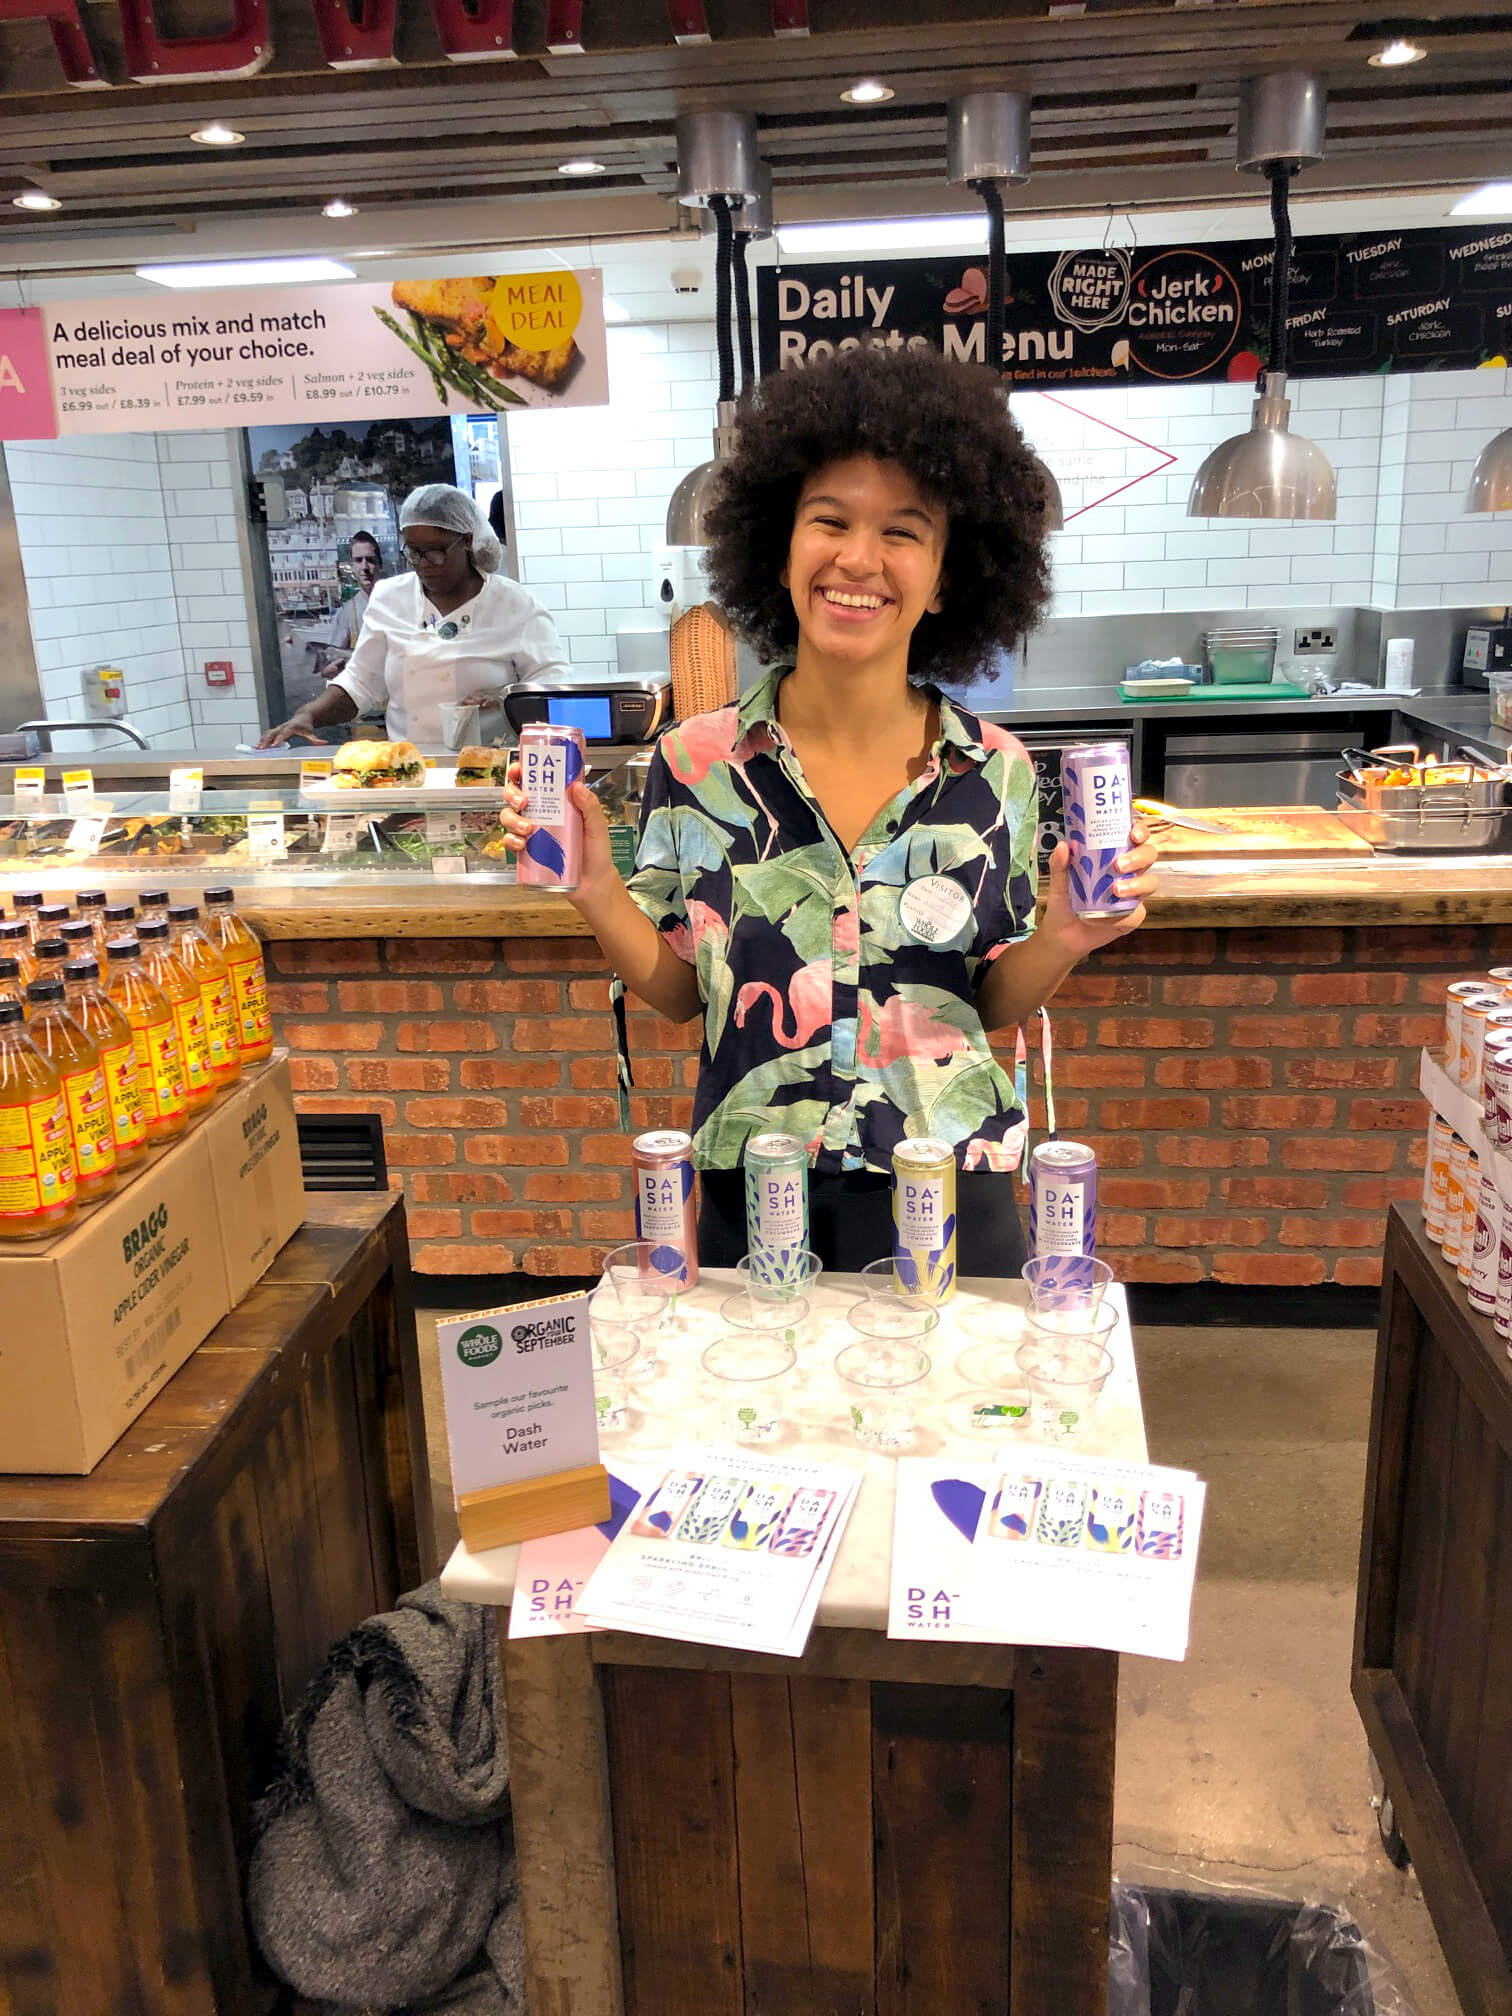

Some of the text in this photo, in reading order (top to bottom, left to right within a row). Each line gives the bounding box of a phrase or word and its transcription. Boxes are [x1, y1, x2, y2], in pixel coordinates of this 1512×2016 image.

[1241, 246, 1297, 272] MONY
[1346, 238, 1403, 264] TUESDAY
[1073, 264, 1117, 279] MADE
[508, 284, 568, 305] MEAL
[1062, 277, 1124, 296] RIGHT
[1152, 272, 1210, 300] Jerk
[778, 276, 895, 328] Daily
[1071, 295, 1111, 310] HERE
[511, 310, 568, 331] DEAL
[1129, 299, 1234, 326] Chicken
[1285, 307, 1328, 330] FRIDAY
[1386, 297, 1451, 327] SATURDAY
[53, 309, 327, 342] A delicious mix and match
[56, 339, 315, 369] meal deal of your choice.
[175, 380, 214, 391] Protein
[227, 379, 234, 389] 2
[235, 378, 254, 390] veg
[255, 376, 284, 387] sides
[304, 372, 345, 384] Salmon
[357, 371, 365, 381] 2
[366, 371, 385, 383] veg
[387, 368, 415, 380] sides
[68, 387, 89, 399] veg
[90, 384, 117, 396] sides
[233, 393, 263, 404] £9.59
[306, 388, 337, 400] £8.99
[364, 385, 399, 397] £10.79
[62, 401, 93, 412] £6.99
[119, 398, 151, 409] £8.39
[528, 770, 554, 784] SH
[1095, 789, 1122, 806] SH
[931, 878, 965, 903] VISITOR
[647, 1193, 673, 1205] SH
[769, 1195, 795, 1209] SH
[906, 1201, 933, 1214] SH
[1046, 1206, 1074, 1219] SH
[123, 1202, 168, 1264] BRAGG
[114, 1290, 137, 1327] APPLE
[138, 1268, 160, 1301] CIDER
[160, 1237, 190, 1278] VINEGAR
[511, 1316, 576, 1343] ORGANIC
[460, 1334, 498, 1349] WHOLE
[516, 1334, 575, 1354] SEPTEMBER
[464, 1345, 499, 1357] FOODS
[473, 1384, 569, 1411] Sample our favourite
[490, 1400, 554, 1419] organic picks.
[507, 1423, 542, 1440] Dash
[502, 1438, 548, 1455] Water
[531, 1577, 584, 1594] DA-
[530, 1595, 573, 1612] SH
[907, 1588, 960, 1603] DA-
[529, 1613, 572, 1623] WATER
[907, 1605, 950, 1620] SH
